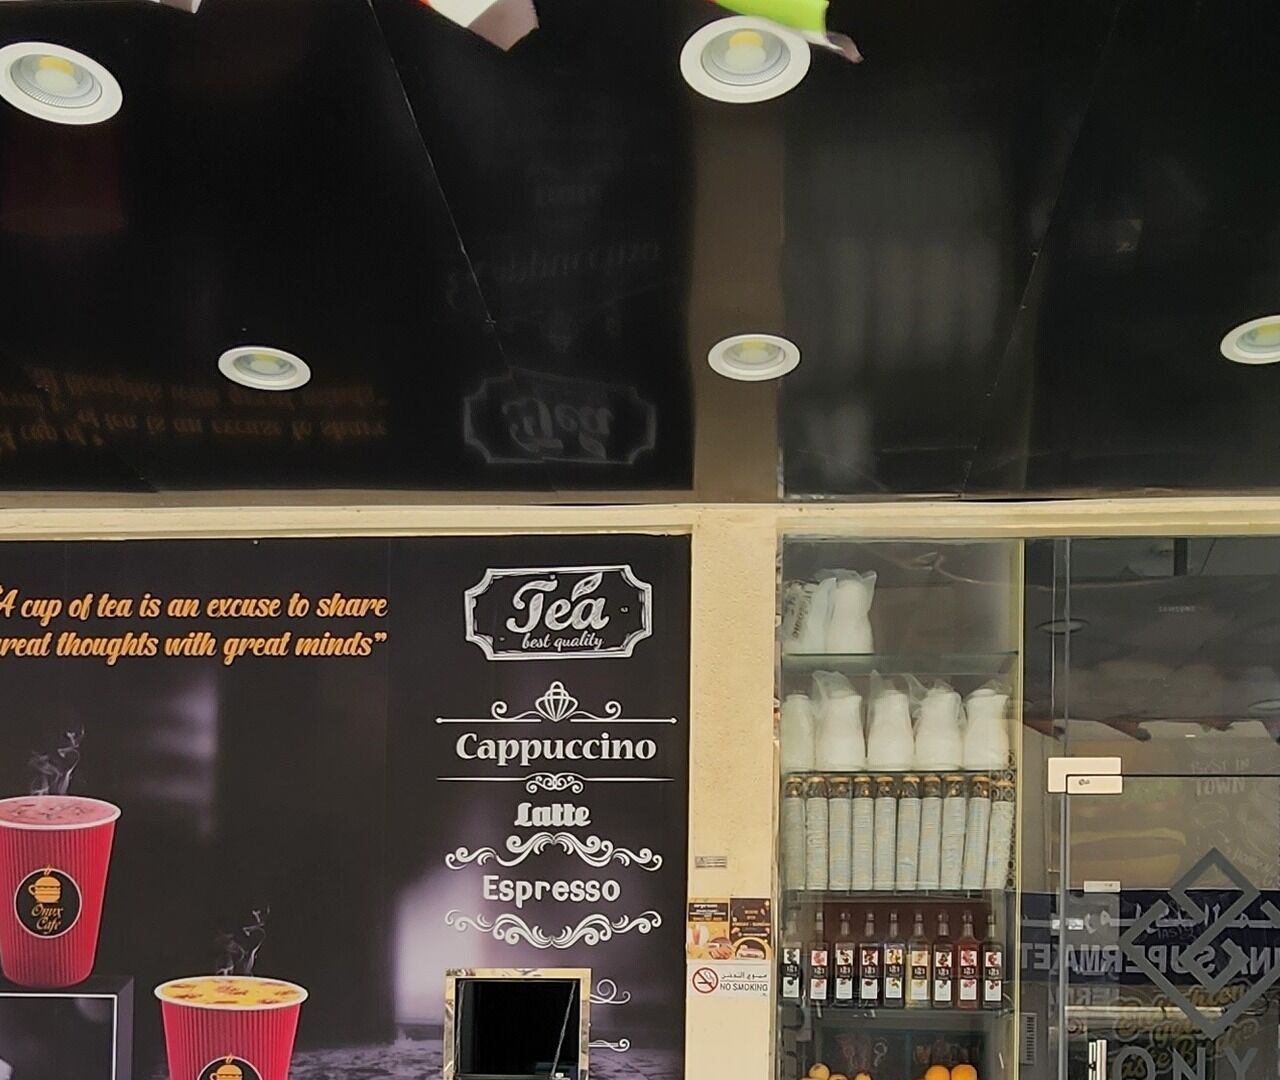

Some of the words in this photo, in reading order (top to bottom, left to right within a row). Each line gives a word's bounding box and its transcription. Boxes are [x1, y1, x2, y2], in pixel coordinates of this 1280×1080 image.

[20, 598, 62, 627] cup
[68, 593, 94, 620] of
[97, 592, 133, 618] tea
[139, 592, 161, 618] is
[167, 597, 202, 618] an
[206, 597, 283, 618] excuse
[287, 592, 310, 618] to
[315, 592, 389, 618] share
[505, 576, 610, 633] Tea
[55, 631, 159, 666] thoughts
[164, 631, 217, 657] with
[222, 631, 290, 666] great
[522, 631, 551, 650] best
[553, 630, 605, 652] quality
[455, 731, 658, 767] Cappuccino
[513, 802, 592, 828] Latte
[482, 874, 621, 909] Espresso
[31, 903, 64, 918] Onyx
[720, 982, 731, 991] NO
[732, 982, 768, 992] SMOKING
